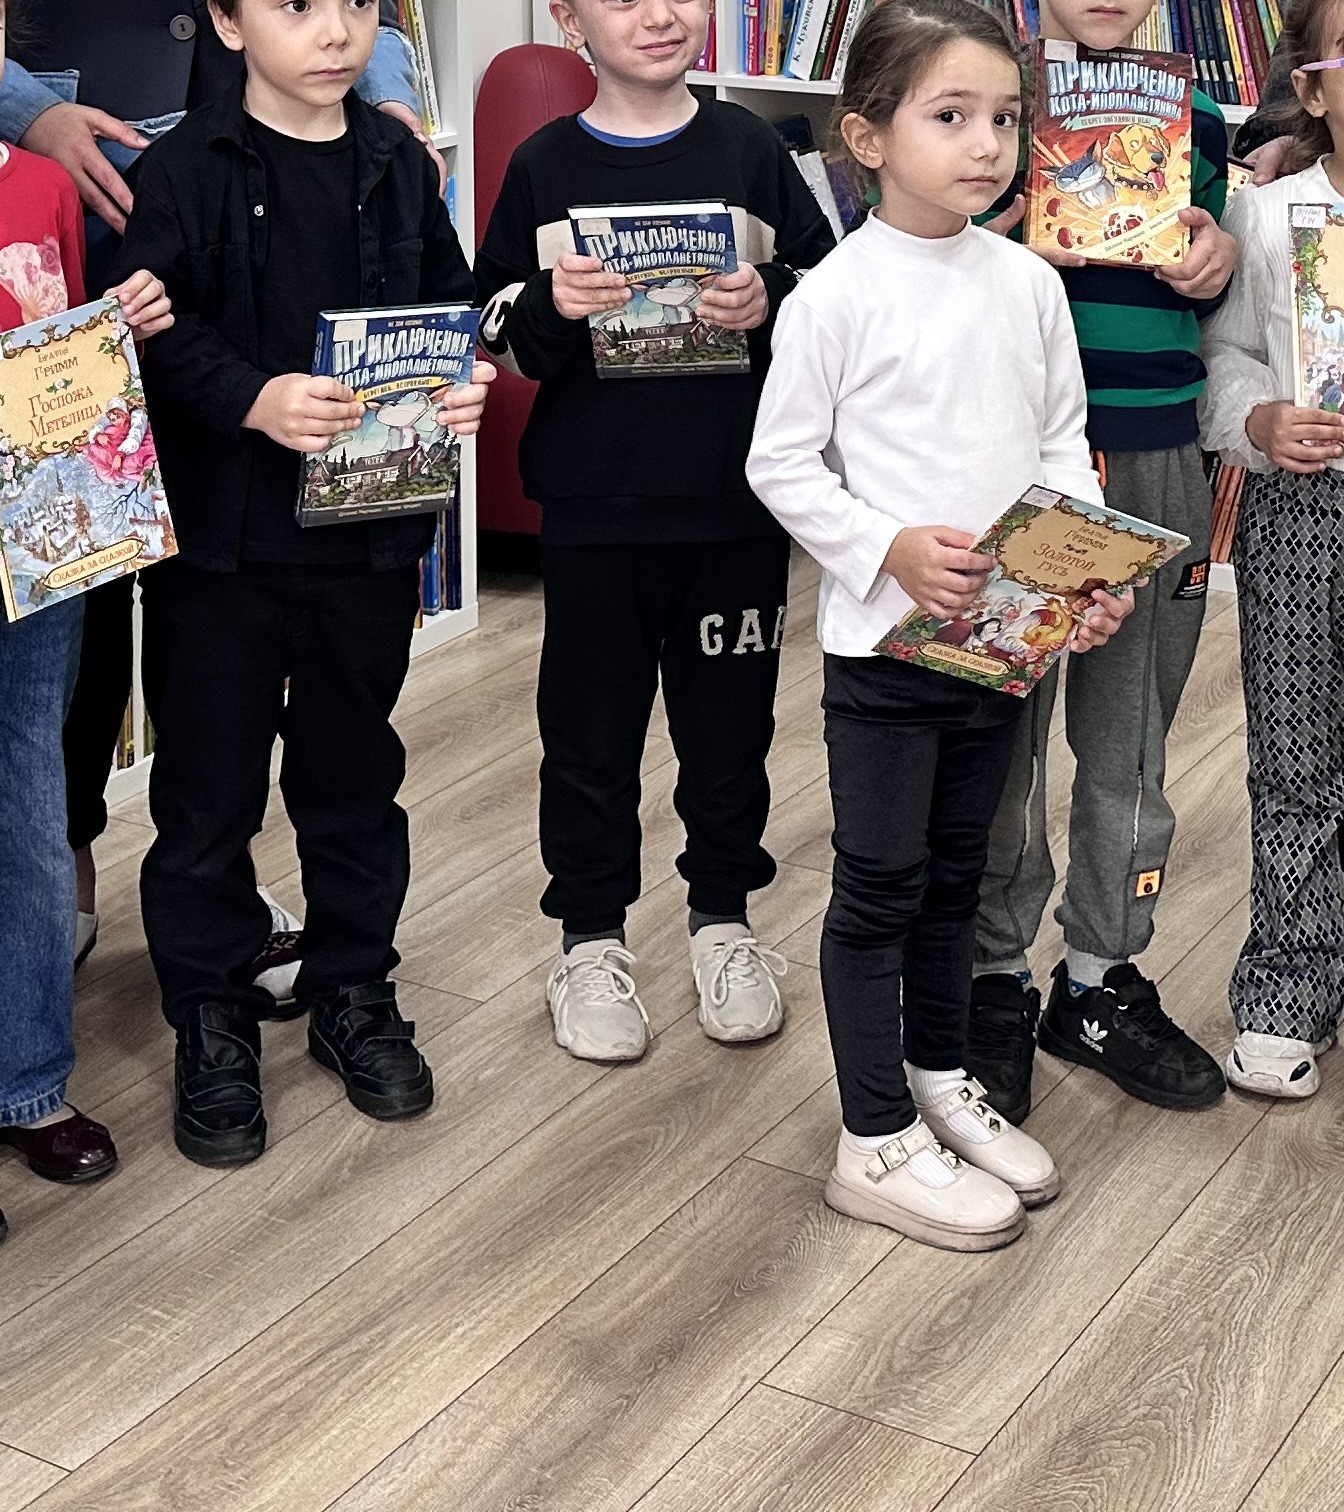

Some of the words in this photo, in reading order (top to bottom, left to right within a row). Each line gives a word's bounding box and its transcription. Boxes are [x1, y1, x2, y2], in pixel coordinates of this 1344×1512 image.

[1047, 60, 1186, 101] ПРИКЛЮЧЕНИЯ
[1047, 92, 1183, 121] КОТА-ИНОПЛАНЕТЯНИНА
[583, 228, 727, 260] ПРИКЛЮЧЕНИЯ
[37, 345, 70, 363] БРАТЬЯ
[333, 326, 471, 376] ПРИКЛЮЧЕНИЯ
[33, 353, 80, 384] ГРИММ
[29, 384, 95, 418] ГОСПОЖА
[27, 402, 104, 444] МЕТЕЛИЦА
[1031, 541, 1097, 573] ЗОЛОТОЙ
[1063, 530, 1110, 552] ГРИММ
[52, 564, 84, 587] СКАЗКА
[84, 558, 98, 575] ЗА
[99, 542, 139, 571] СКАЗКОЙ
[1036, 560, 1070, 579] ГУСЬ
